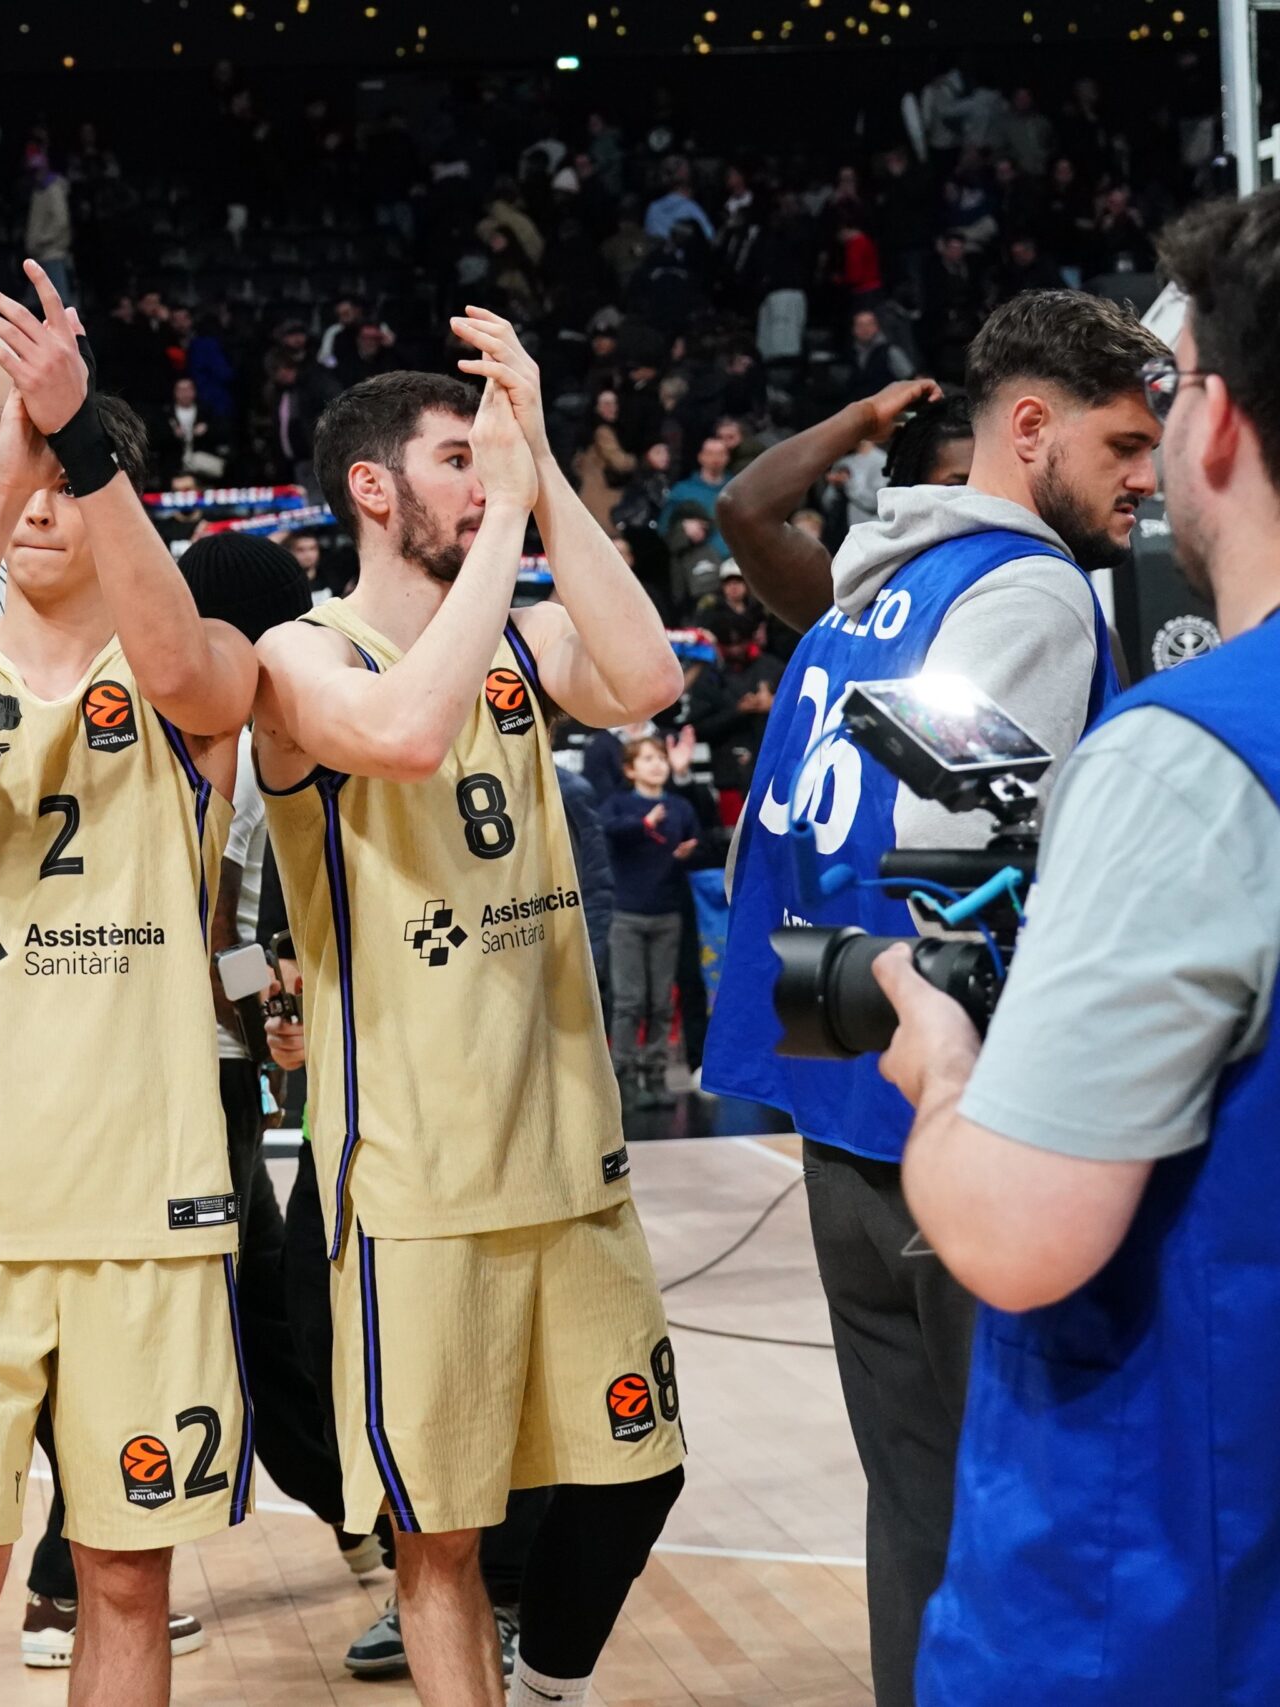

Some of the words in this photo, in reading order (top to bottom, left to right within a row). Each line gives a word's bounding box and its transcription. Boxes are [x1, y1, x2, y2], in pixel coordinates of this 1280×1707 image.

[91, 738, 108, 747] abu
[109, 733, 135, 744] dhabi
[456, 773, 516, 860] 8
[38, 794, 84, 881] 2
[481, 887, 580, 927] Assistència
[24, 922, 165, 947] Assistència
[481, 922, 545, 955] Sanitària
[24, 950, 130, 976] Sanitària
[649, 1336, 679, 1422] 8
[615, 1428, 631, 1438] abu
[631, 1420, 654, 1433] dhabi
[175, 1405, 229, 1500] 2
[129, 1492, 146, 1501] abu
[146, 1489, 172, 1500] dhabi
